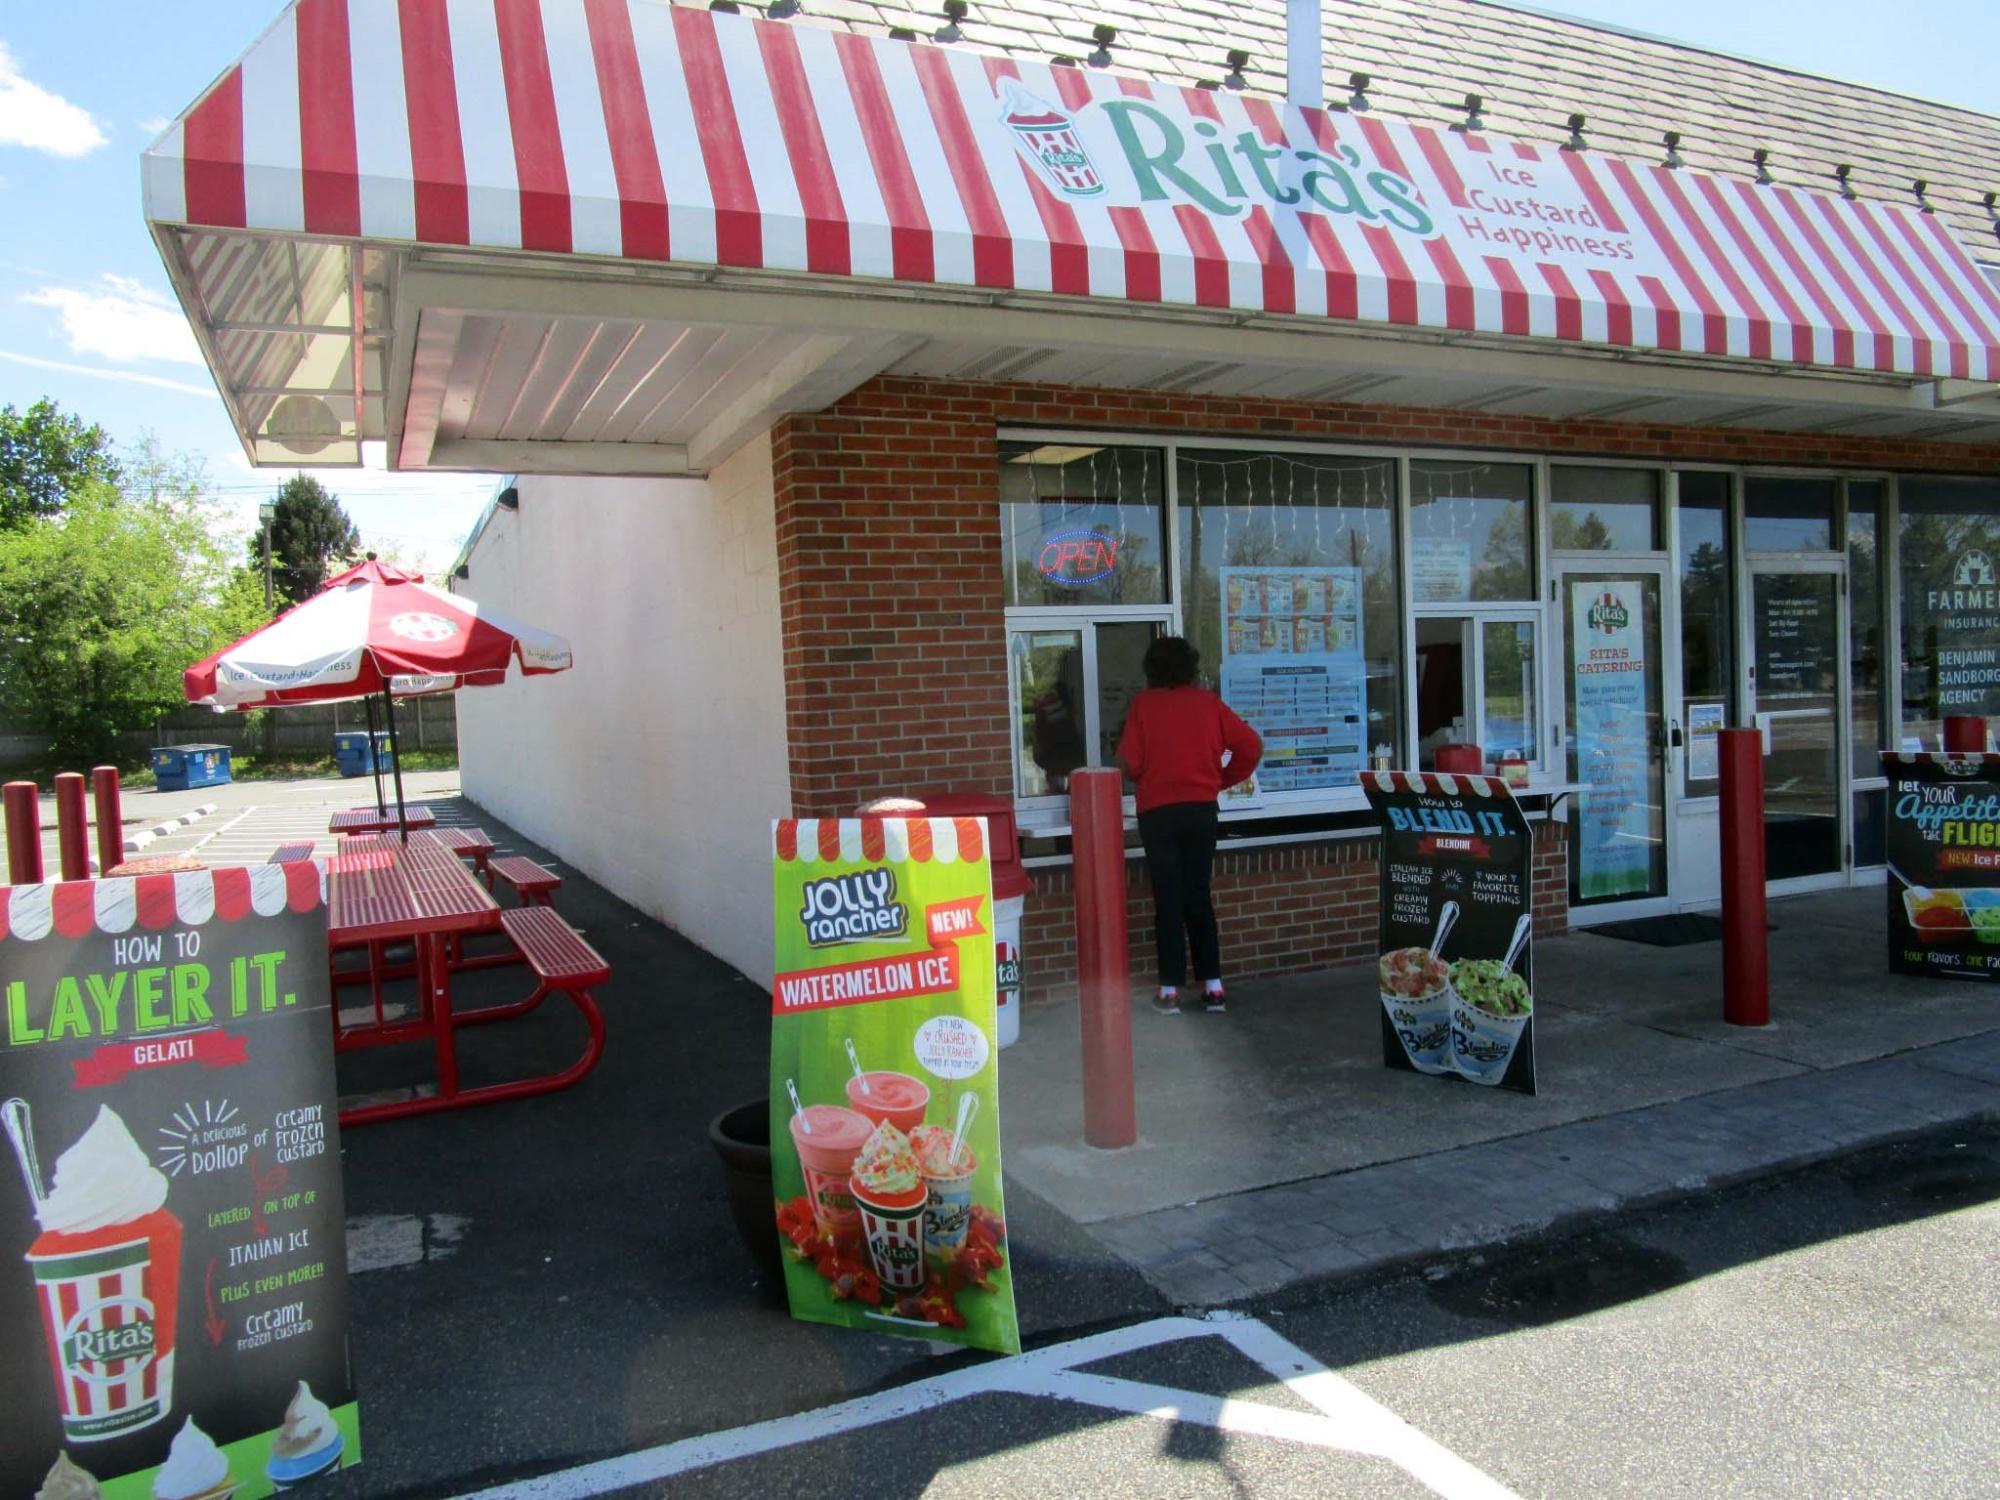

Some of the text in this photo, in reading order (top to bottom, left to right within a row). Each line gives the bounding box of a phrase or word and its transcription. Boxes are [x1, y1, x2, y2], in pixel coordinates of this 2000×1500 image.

[1101, 100, 1434, 235] Rita's
[1487, 160, 1538, 190] Ice
[1470, 188, 1600, 228] Custard
[1459, 214, 1631, 260] Happiness
[1039, 540, 1119, 575] OPEN
[1593, 605, 1625, 623] Rita's
[1589, 648, 1629, 661] RITA'S
[1938, 651, 1996, 667] BENJAMIN
[1576, 661, 1643, 674] CATERING
[1938, 690, 1986, 706] AGENCY
[1898, 780, 1920, 792] let
[1922, 786, 1956, 804] YOUR
[1386, 806, 1516, 837] BLEND IT.
[1948, 852, 1970, 865] NEW
[1974, 854, 1991, 865] Ice
[1390, 864, 1433, 876] ITALIAN ICE
[1391, 872, 1431, 885] BLENDED
[803, 871, 889, 920] JOLLY
[1472, 881, 1520, 894] FAVORITE
[1394, 894, 1428, 906] CREAMY
[1394, 902, 1427, 914] FROZEN
[1472, 892, 1521, 905] TOPPINGS
[809, 906, 900, 941] rancher
[931, 908, 974, 934] NEW!
[1392, 913, 1430, 925] CUSTARD
[114, 931, 201, 966] HOW TO
[1928, 952, 1961, 966] Flavors
[779, 956, 953, 1008] WATERMELON ICE
[6, 950, 297, 1046] LAYER IT.
[133, 1039, 195, 1065] GELATI
[192, 1133, 199, 1146] A
[208, 1190, 317, 1228] LAYERED ON TOP OF
[229, 1229, 310, 1267] ITALIAN ICE
[877, 1241, 917, 1261] Rita's
[220, 1281, 250, 1304] PLUS
[255, 1273, 283, 1294] EVEN
[73, 1320, 155, 1363] Rita's
